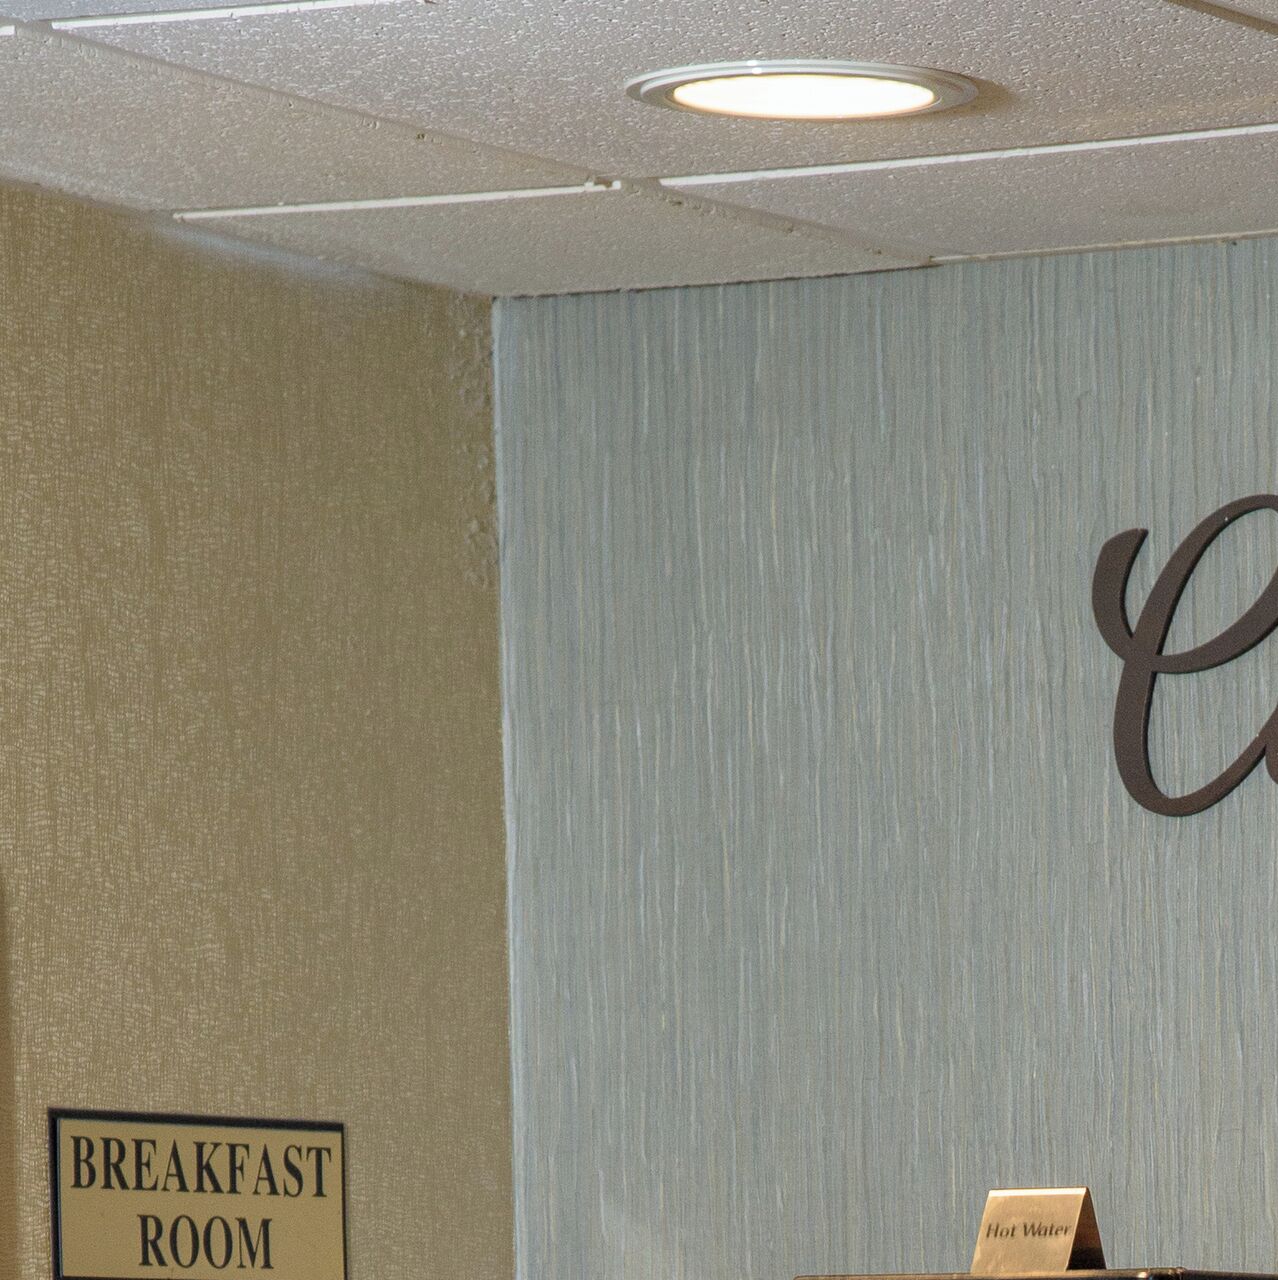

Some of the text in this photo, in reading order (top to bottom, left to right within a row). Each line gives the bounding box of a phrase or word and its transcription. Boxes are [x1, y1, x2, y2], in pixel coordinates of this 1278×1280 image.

[70, 1135, 332, 1198] BREAKFAST
[137, 1214, 274, 1270] ROOM
[986, 1221, 1072, 1238] Hot Water
